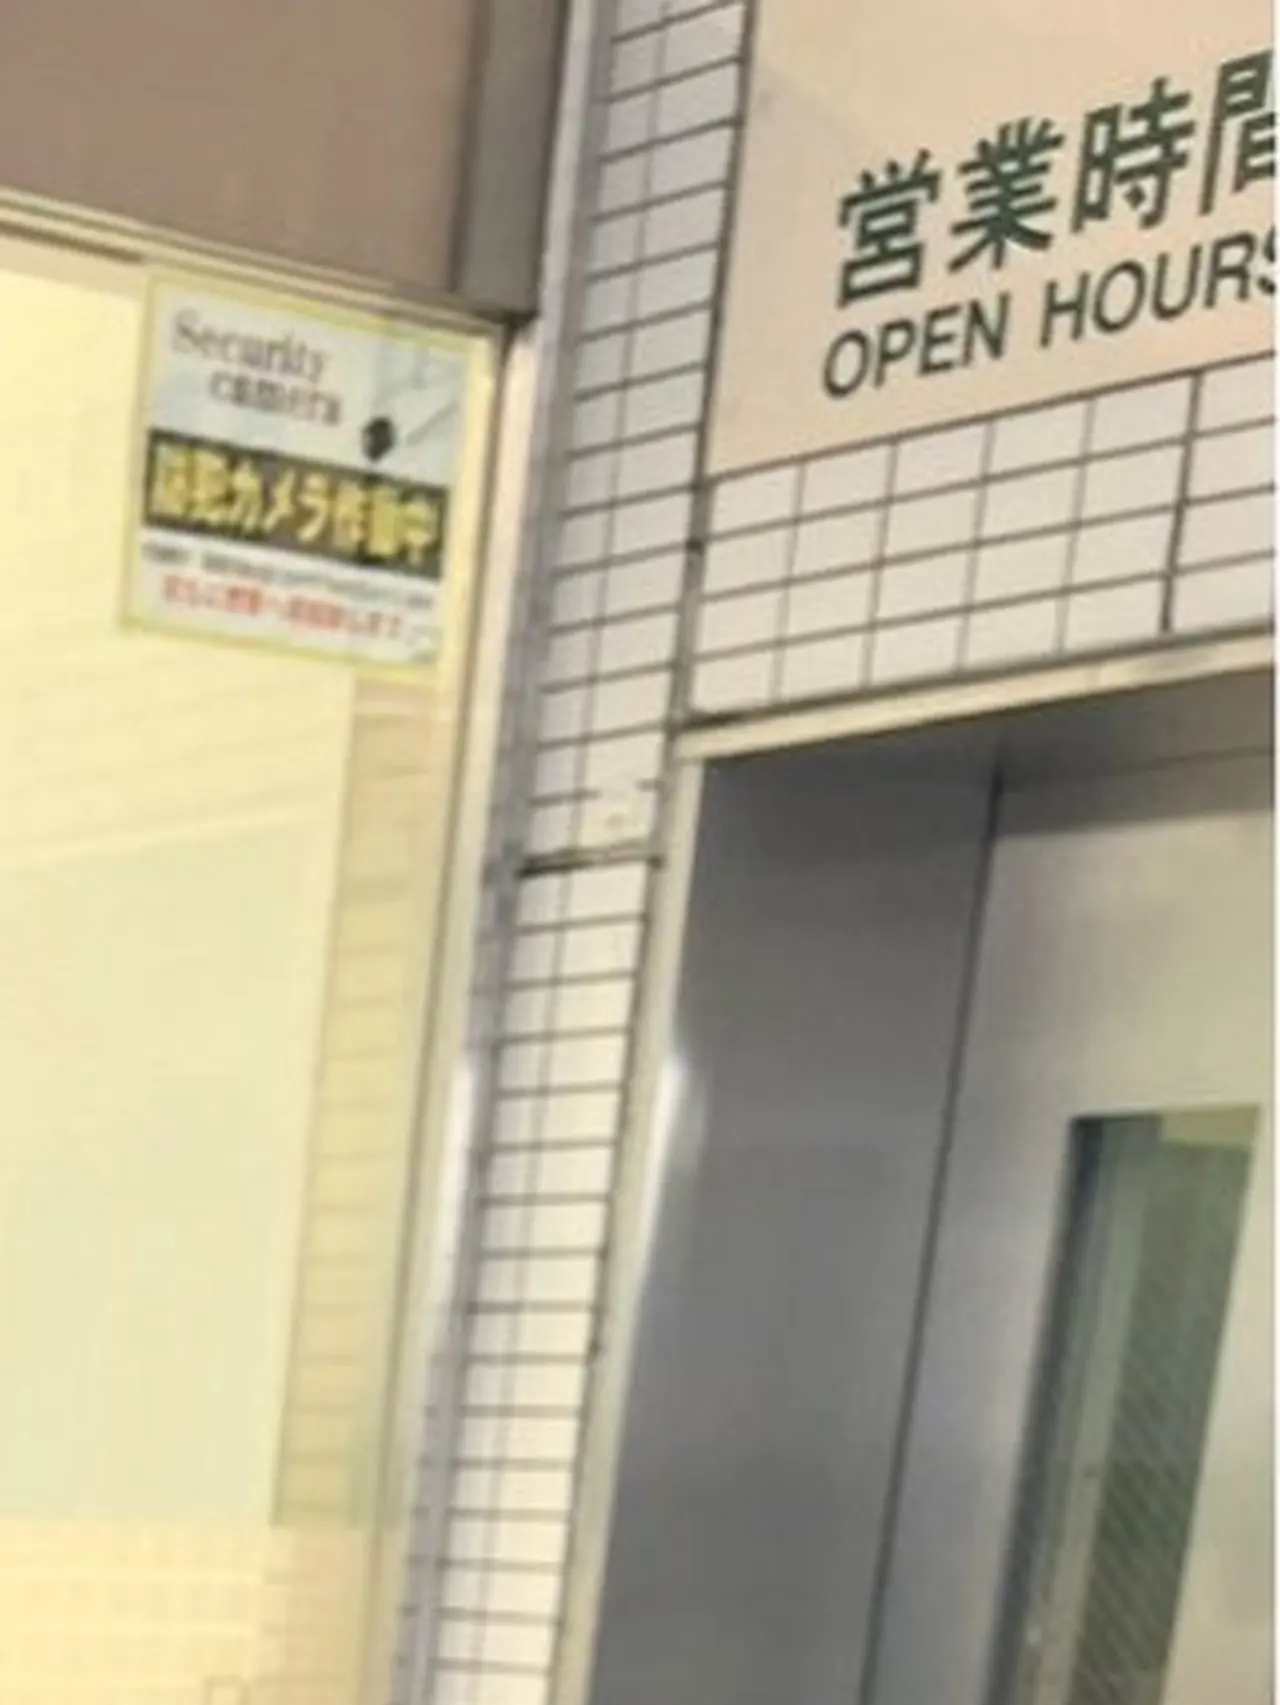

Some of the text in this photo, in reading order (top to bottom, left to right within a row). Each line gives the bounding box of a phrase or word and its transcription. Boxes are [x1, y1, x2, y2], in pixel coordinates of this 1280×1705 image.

[836, 49, 1274, 309] 営業時間
[172, 308, 329, 384] Security
[821, 293, 1012, 400] OPEN
